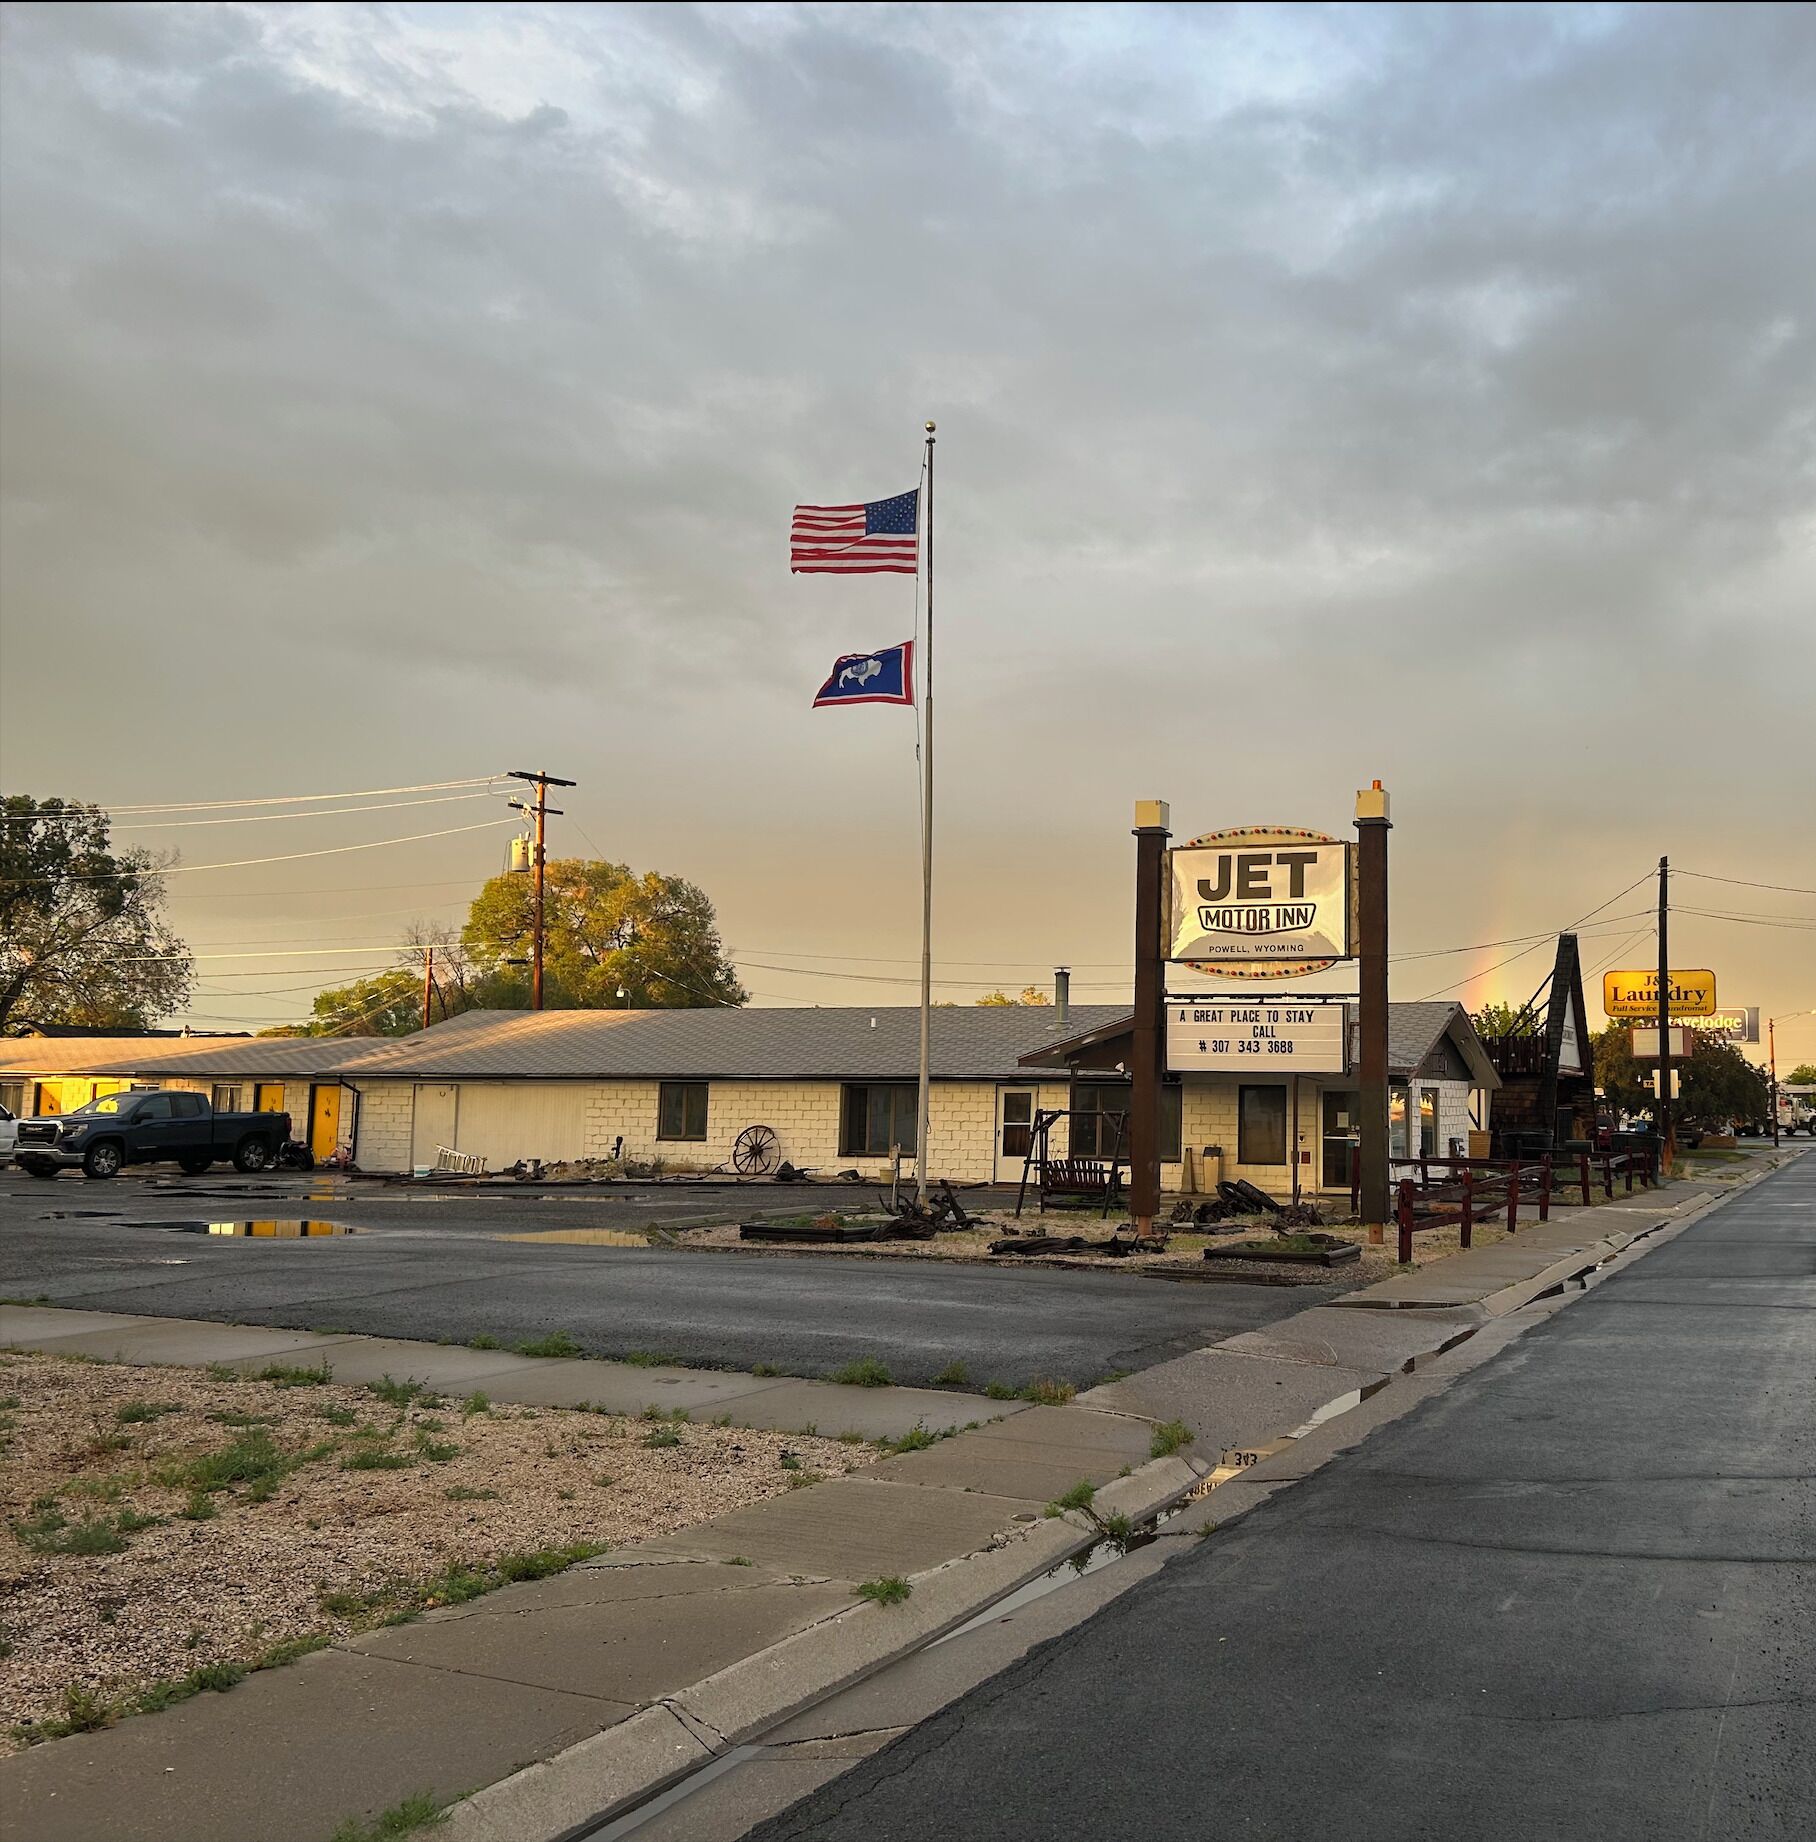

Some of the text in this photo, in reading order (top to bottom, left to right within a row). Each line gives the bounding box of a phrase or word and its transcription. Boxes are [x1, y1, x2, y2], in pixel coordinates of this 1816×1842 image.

[1197, 852, 1318, 901] JET
[1205, 908, 1308, 931] MOTOR INN
[1209, 944, 1304, 954] POWELL, WYOMING
[1180, 1010, 1314, 1023] A GREAT PLACE TO STAY
[1253, 1025, 1276, 1038] CALL
[1199, 1040, 1293, 1053] # 307 343 3688
